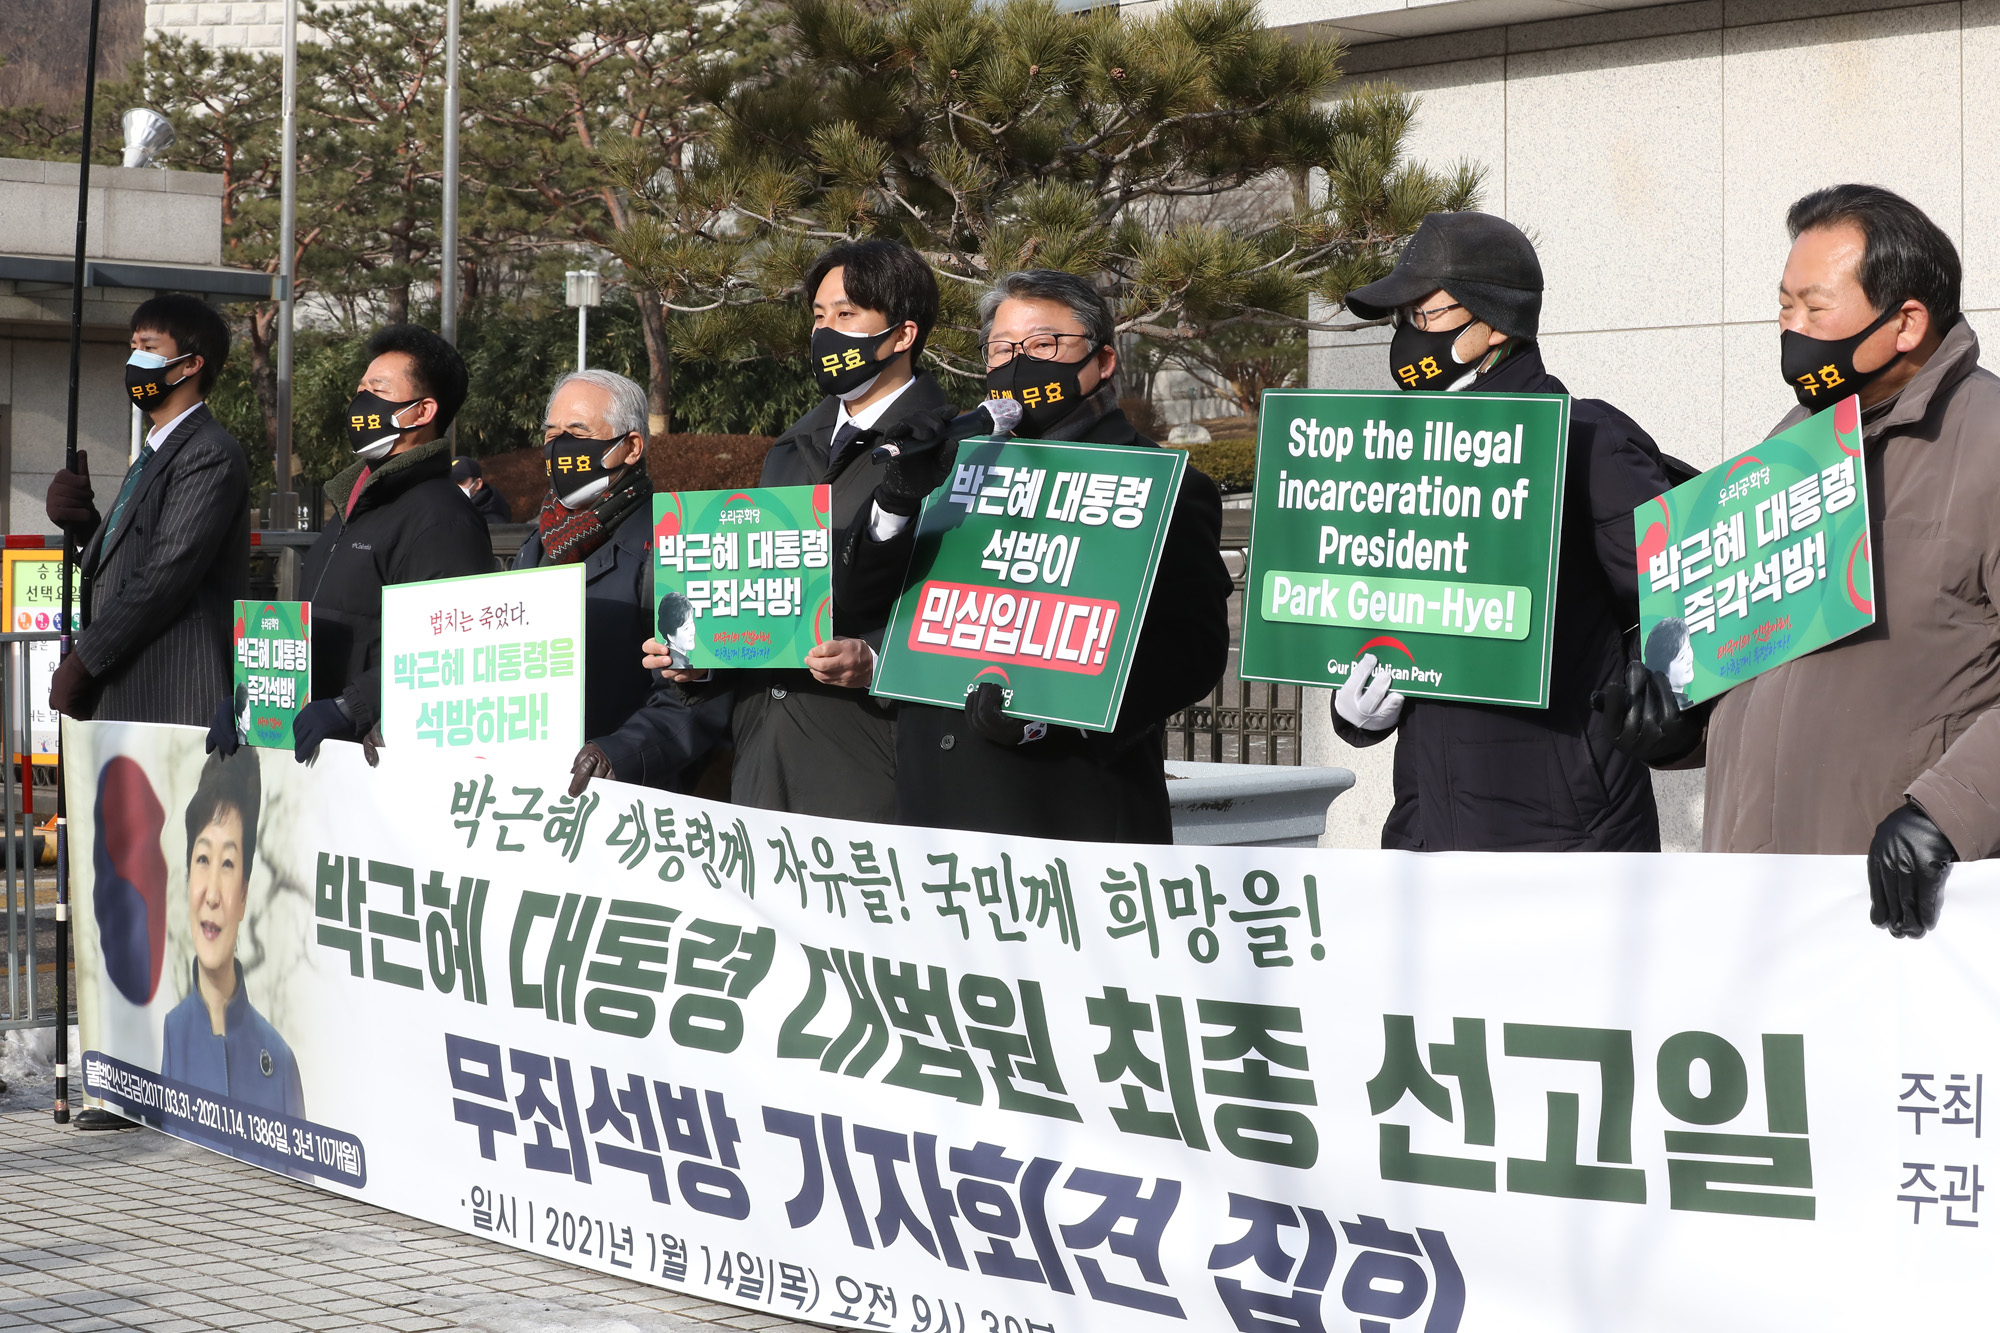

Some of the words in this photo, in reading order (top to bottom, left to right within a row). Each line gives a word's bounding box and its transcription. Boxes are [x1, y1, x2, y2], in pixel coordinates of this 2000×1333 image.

[821, 348, 866, 377] 무효
[1398, 355, 1443, 387] 무효
[1796, 364, 1846, 396] 무효
[131, 383, 160, 400] 무효
[1022, 382, 1065, 409] 무효
[351, 414, 382, 432] 무효
[1288, 417, 1354, 462] Stop
[1362, 419, 1414, 461] the
[1423, 421, 1524, 468] illegal
[557, 454, 592, 474] 무효
[1718, 466, 1770, 506] 우리공화당
[719, 508, 761, 525] 우리공화당
[948, 464, 1047, 519] 박근혜
[1045, 471, 1153, 529] 대통령
[1277, 470, 1482, 518] incarceration
[1491, 477, 1530, 520] of
[1648, 510, 1747, 593] 박근혜
[1754, 455, 1858, 549] 대통령
[658, 532, 740, 572] 박근혜
[747, 528, 829, 569] 대통령
[980, 529, 1081, 588] 석방이
[1318, 525, 1470, 574] President
[686, 577, 802, 618] 무죄석방!
[1271, 575, 1341, 619] Park
[1347, 580, 1516, 633] Geun-Hye!
[1683, 530, 1827, 637] 즉각석방!
[430, 608, 474, 636] 법치는
[479, 601, 530, 631] 죽었다.
[917, 587, 1117, 665] 민심입니다!
[237, 638, 270, 669] 박근혜
[272, 639, 307, 671] 대통령
[394, 648, 464, 690] 박근혜
[473, 637, 574, 683] 대통령을
[1327, 659, 1349, 675] Our
[1411, 666, 1442, 687] Party
[248, 675, 295, 709] 즉각석방!
[416, 692, 548, 748] 석방하라!
[450, 773, 600, 864] 박근혜
[605, 798, 756, 900] 대통령께
[766, 825, 911, 925] 자유를!
[922, 851, 1082, 952] 국민께
[1100, 861, 1326, 968] 희망을!
[315, 851, 491, 1006] 박근혜
[509, 890, 777, 1055] 대통령
[776, 943, 1085, 1124] 대법원
[1085, 985, 1319, 1170] 최종
[1365, 1013, 1817, 1221] 선고일
[1897, 1072, 1983, 1138] 주최
[292, 1128, 315, 1162] 3년
[315, 1135, 362, 1177] 10개월)
[444, 1031, 751, 1222] 무죄석방
[762, 1104, 1188, 1321] 기자회견
[1896, 1162, 1985, 1228] 주관
[546, 1206, 634, 1269] 2021년
[646, 1232, 688, 1283] 1월
[700, 1245, 820, 1313] 14일(목)
[830, 1275, 897, 1328] 오전
[911, 1293, 966, 1333] 9시
